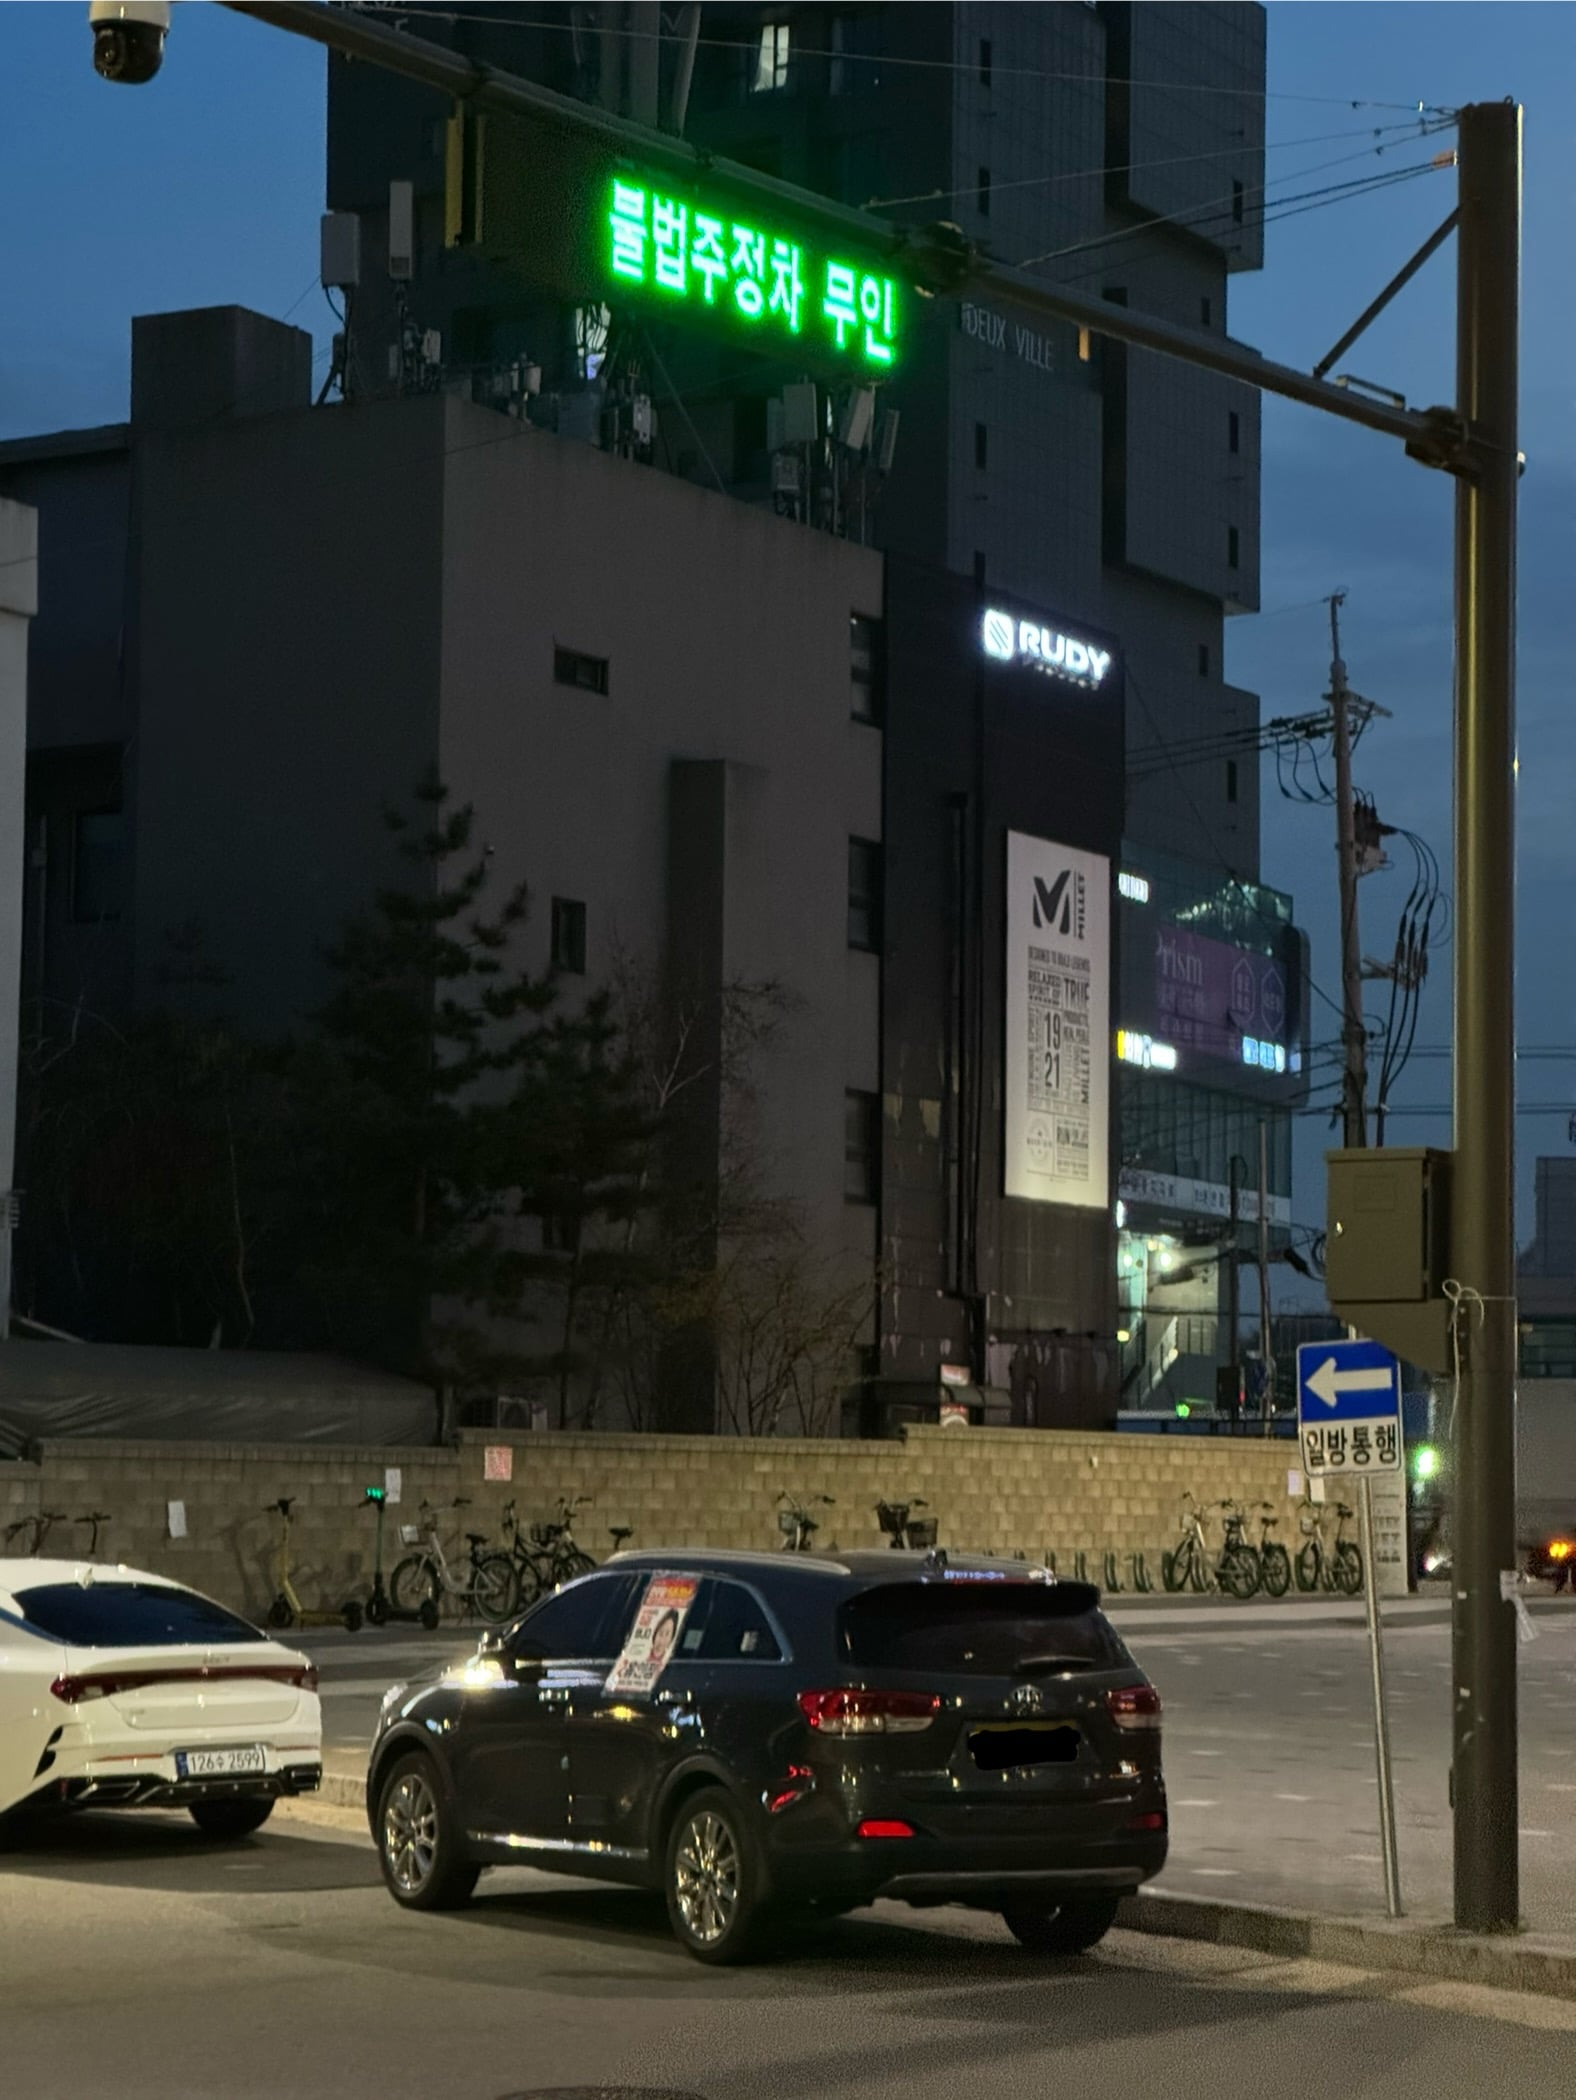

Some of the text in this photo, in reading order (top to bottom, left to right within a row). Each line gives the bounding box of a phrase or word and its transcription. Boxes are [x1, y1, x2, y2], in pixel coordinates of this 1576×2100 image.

[609, 177, 894, 364] 불법주정차 무인
[964, 303, 1054, 371] DEUX VILLE
[1018, 620, 1111, 681] RUDY
[1077, 873, 1085, 941] MILLET
[1044, 1011, 1061, 1050] 19
[1044, 1051, 1061, 1089] 21
[1080, 1047, 1090, 1104] MILLET
[1306, 1424, 1397, 1467] 일방통행
[228, 1751, 261, 1770] 2599
